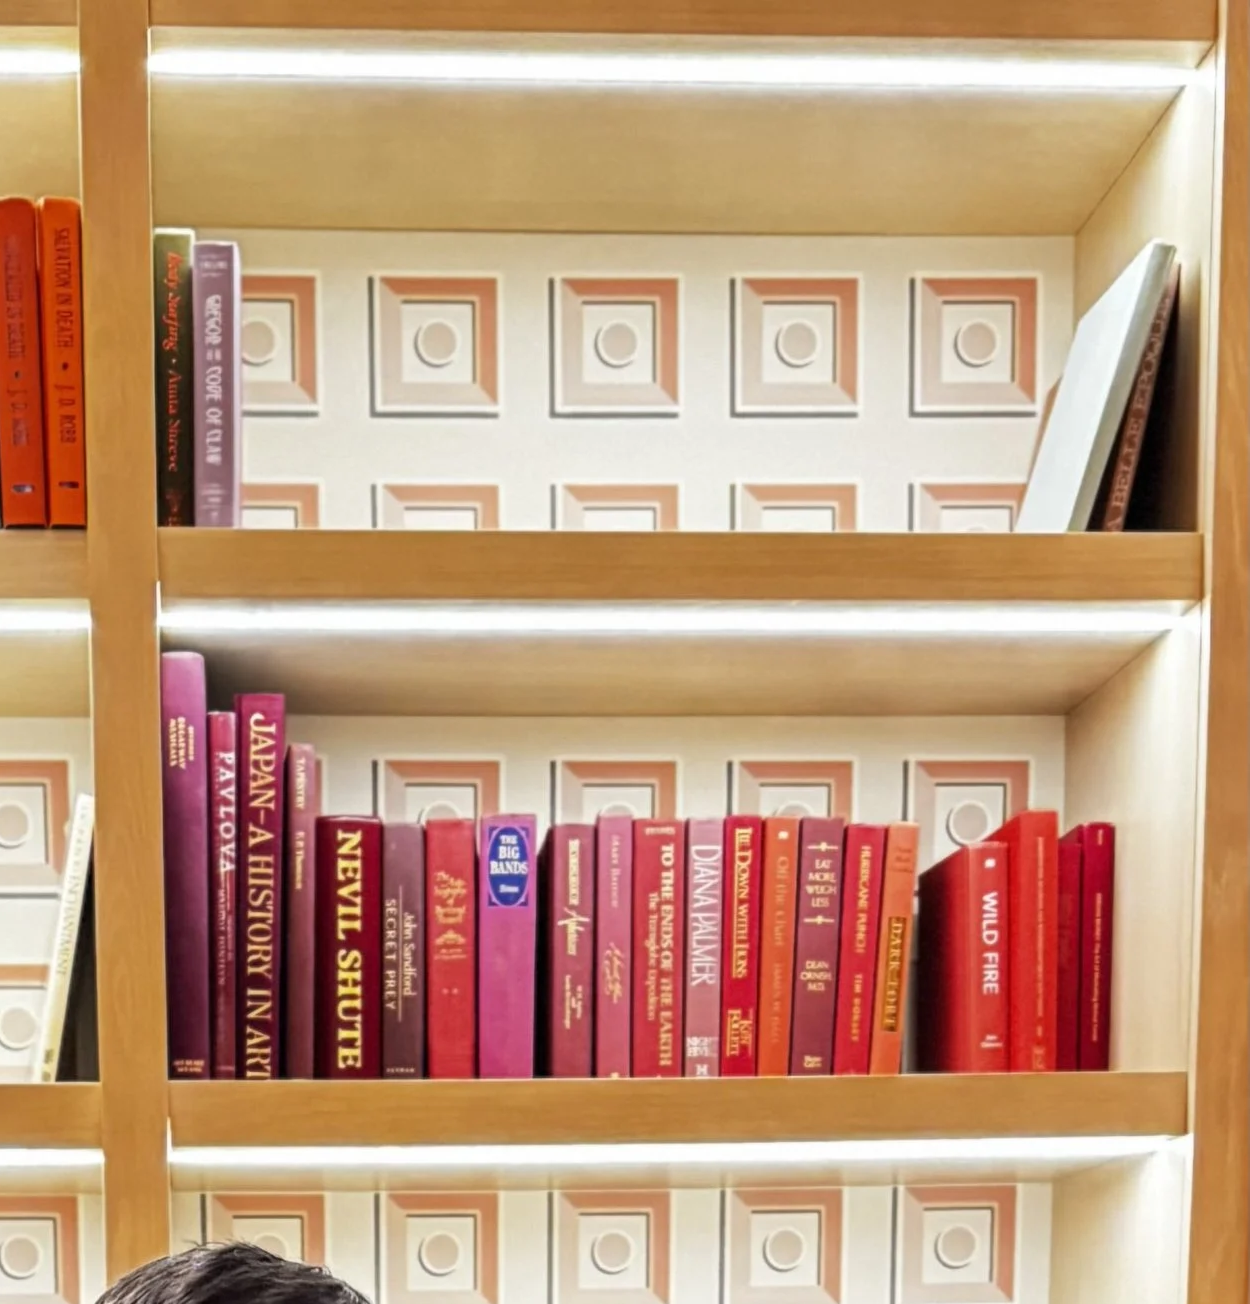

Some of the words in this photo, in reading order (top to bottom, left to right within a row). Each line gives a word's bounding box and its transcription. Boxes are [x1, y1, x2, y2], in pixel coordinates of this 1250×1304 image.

[54, 227, 72, 288] SALVATION
[164, 252, 181, 288] Body
[57, 293, 71, 305] IN
[58, 310, 73, 348] DEATH
[162, 292, 182, 352] Surfing
[204, 294, 222, 345] GREGOR
[168, 370, 181, 414] Anita
[60, 414, 76, 443] ROBB
[168, 419, 181, 472] Shreve
[295, 757, 306, 810] TAPESTRY
[219, 751, 236, 874] PAVLOVA
[499, 845, 520, 859] BIG
[500, 835, 517, 844] THE
[661, 844, 674, 867] TO
[735, 828, 752, 847] LIE
[490, 860, 528, 875] BANDS
[692, 845, 722, 908] DIANA
[735, 850, 752, 898] DOWN
[777, 856, 789, 879] Off
[814, 859, 832, 869] EAT
[857, 845, 872, 910] HURRICANE
[336, 829, 362, 941] NEVIL
[648, 892, 658, 912] The
[661, 869, 674, 900] THE
[775, 884, 787, 905] the
[805, 884, 837, 895] WEIGH
[811, 898, 830, 907] LESS
[246, 853, 274, 979] HISTORY
[385, 898, 397, 962] SECRET
[403, 912, 416, 940] John
[660, 904, 674, 948] ENDS
[736, 903, 749, 938] WITH
[854, 913, 867, 953] PUNCH
[981, 891, 998, 944] WILD
[660, 950, 673, 972] OF
[691, 913, 719, 986] PALMER
[888, 919, 903, 971] DARK
[403, 943, 417, 996] Sandford
[805, 961, 829, 970] DEAN
[853, 974, 863, 993] TIM
[982, 952, 999, 995] FIRE
[245, 988, 272, 1019] IN
[336, 948, 363, 1069] SHUTE
[385, 970, 397, 1010] PREY
[660, 977, 673, 1007] THE
[659, 1011, 673, 1067] EARTH
[728, 1009, 741, 1056] FOLLETT
[739, 1019, 751, 1045] KEN
[245, 1028, 272, 1079] ART
